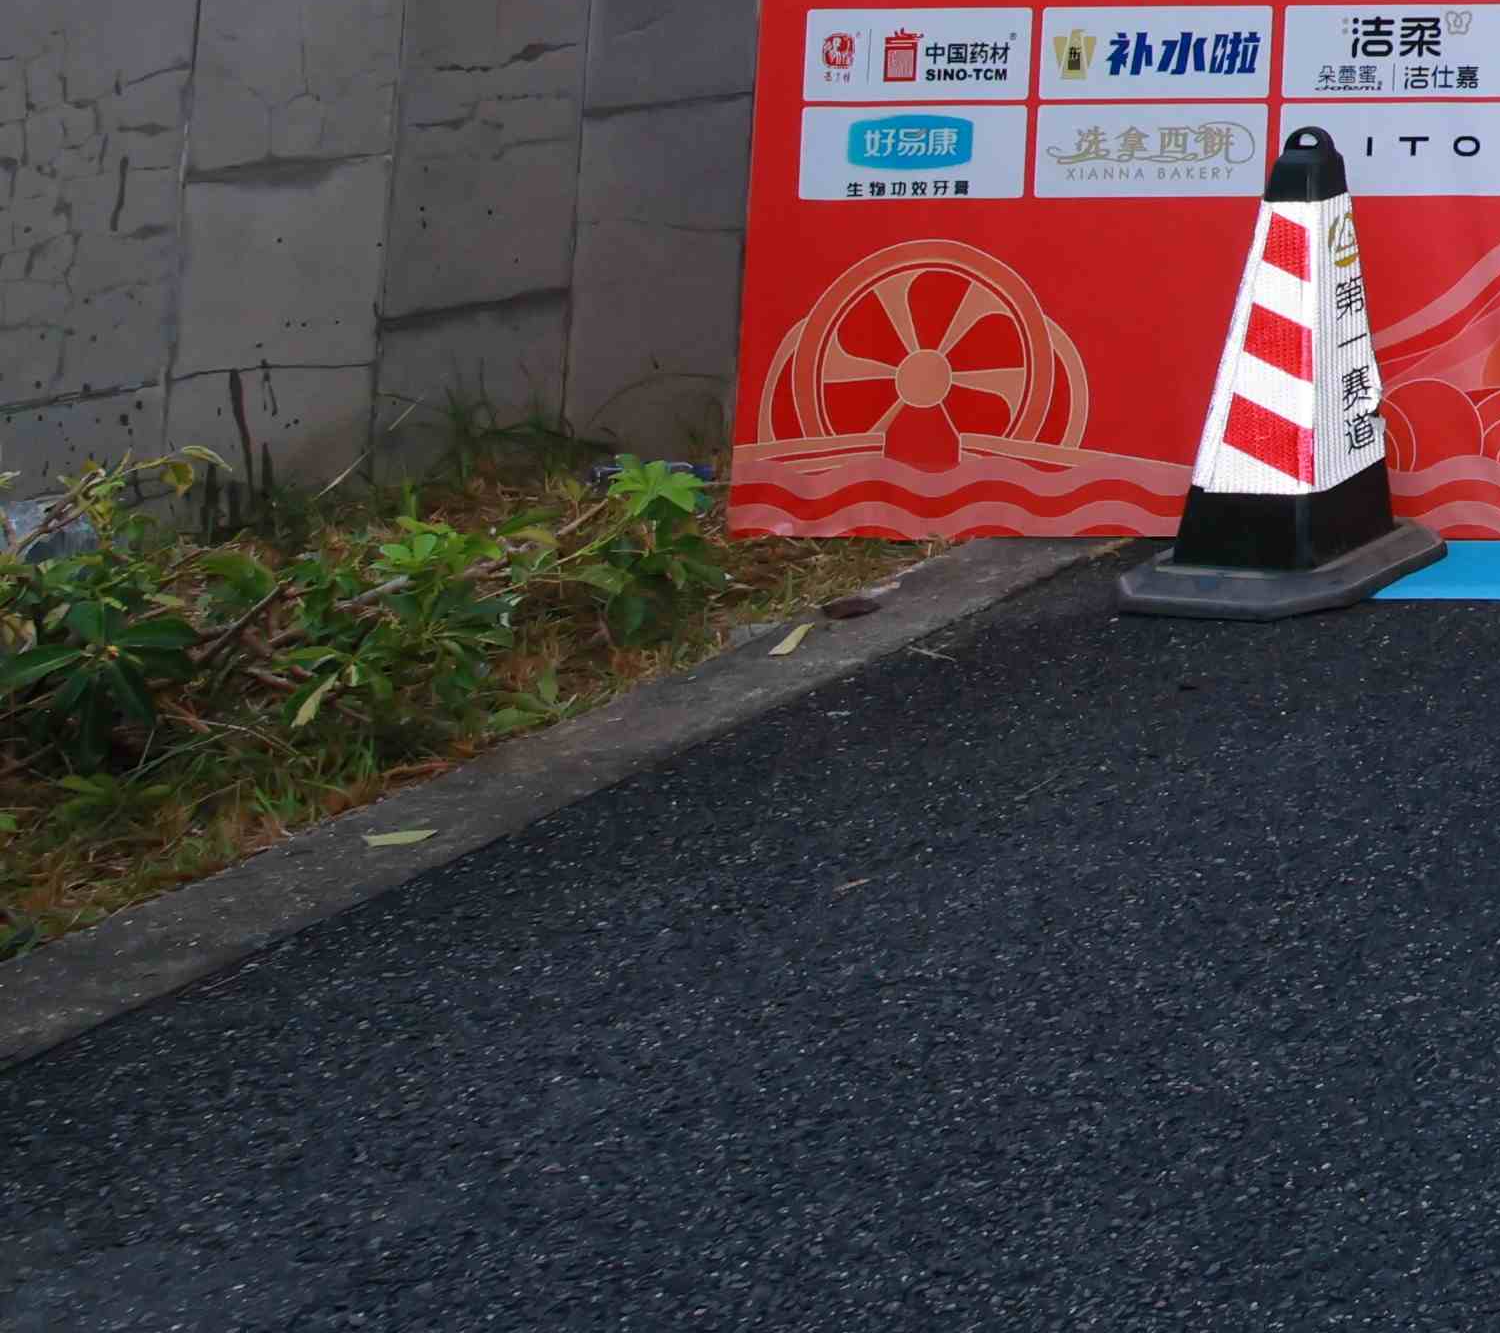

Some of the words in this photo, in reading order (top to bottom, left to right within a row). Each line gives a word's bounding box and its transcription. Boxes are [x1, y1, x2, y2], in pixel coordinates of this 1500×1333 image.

[1351, 16, 1442, 59] 洁柔
[925, 43, 1010, 65] 中国药材
[1106, 31, 1261, 76] 补水啦
[925, 68, 1008, 82] SINO-TCM
[1403, 65, 1480, 91] 洁仕嘉
[1065, 167, 1144, 181] XIANNA
[1157, 166, 1235, 181] BAKERY
[845, 180, 970, 198] 生物功效牙膏
